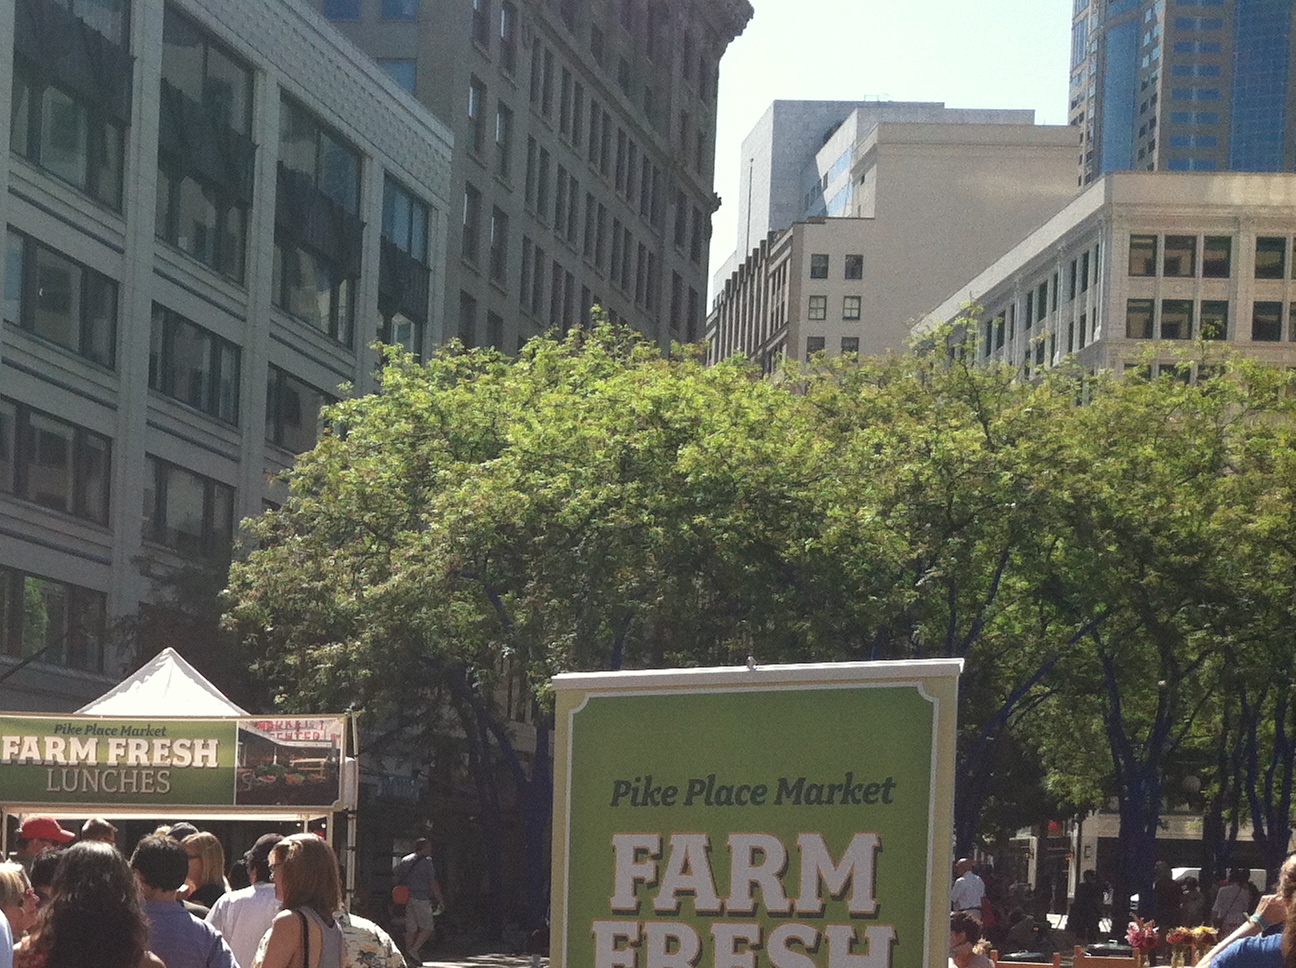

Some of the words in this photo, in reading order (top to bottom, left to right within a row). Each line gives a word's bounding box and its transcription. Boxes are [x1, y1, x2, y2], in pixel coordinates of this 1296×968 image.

[54, 724, 82, 737] Pike
[84, 724, 117, 737] Place
[120, 724, 168, 737] Market
[1, 736, 98, 766] FARM
[106, 738, 219, 768] FRESH
[46, 768, 171, 794] LUNCHES
[610, 776, 677, 808] Pike
[684, 775, 768, 808] Place
[774, 773, 896, 806] Market
[609, 831, 882, 918] FARM
